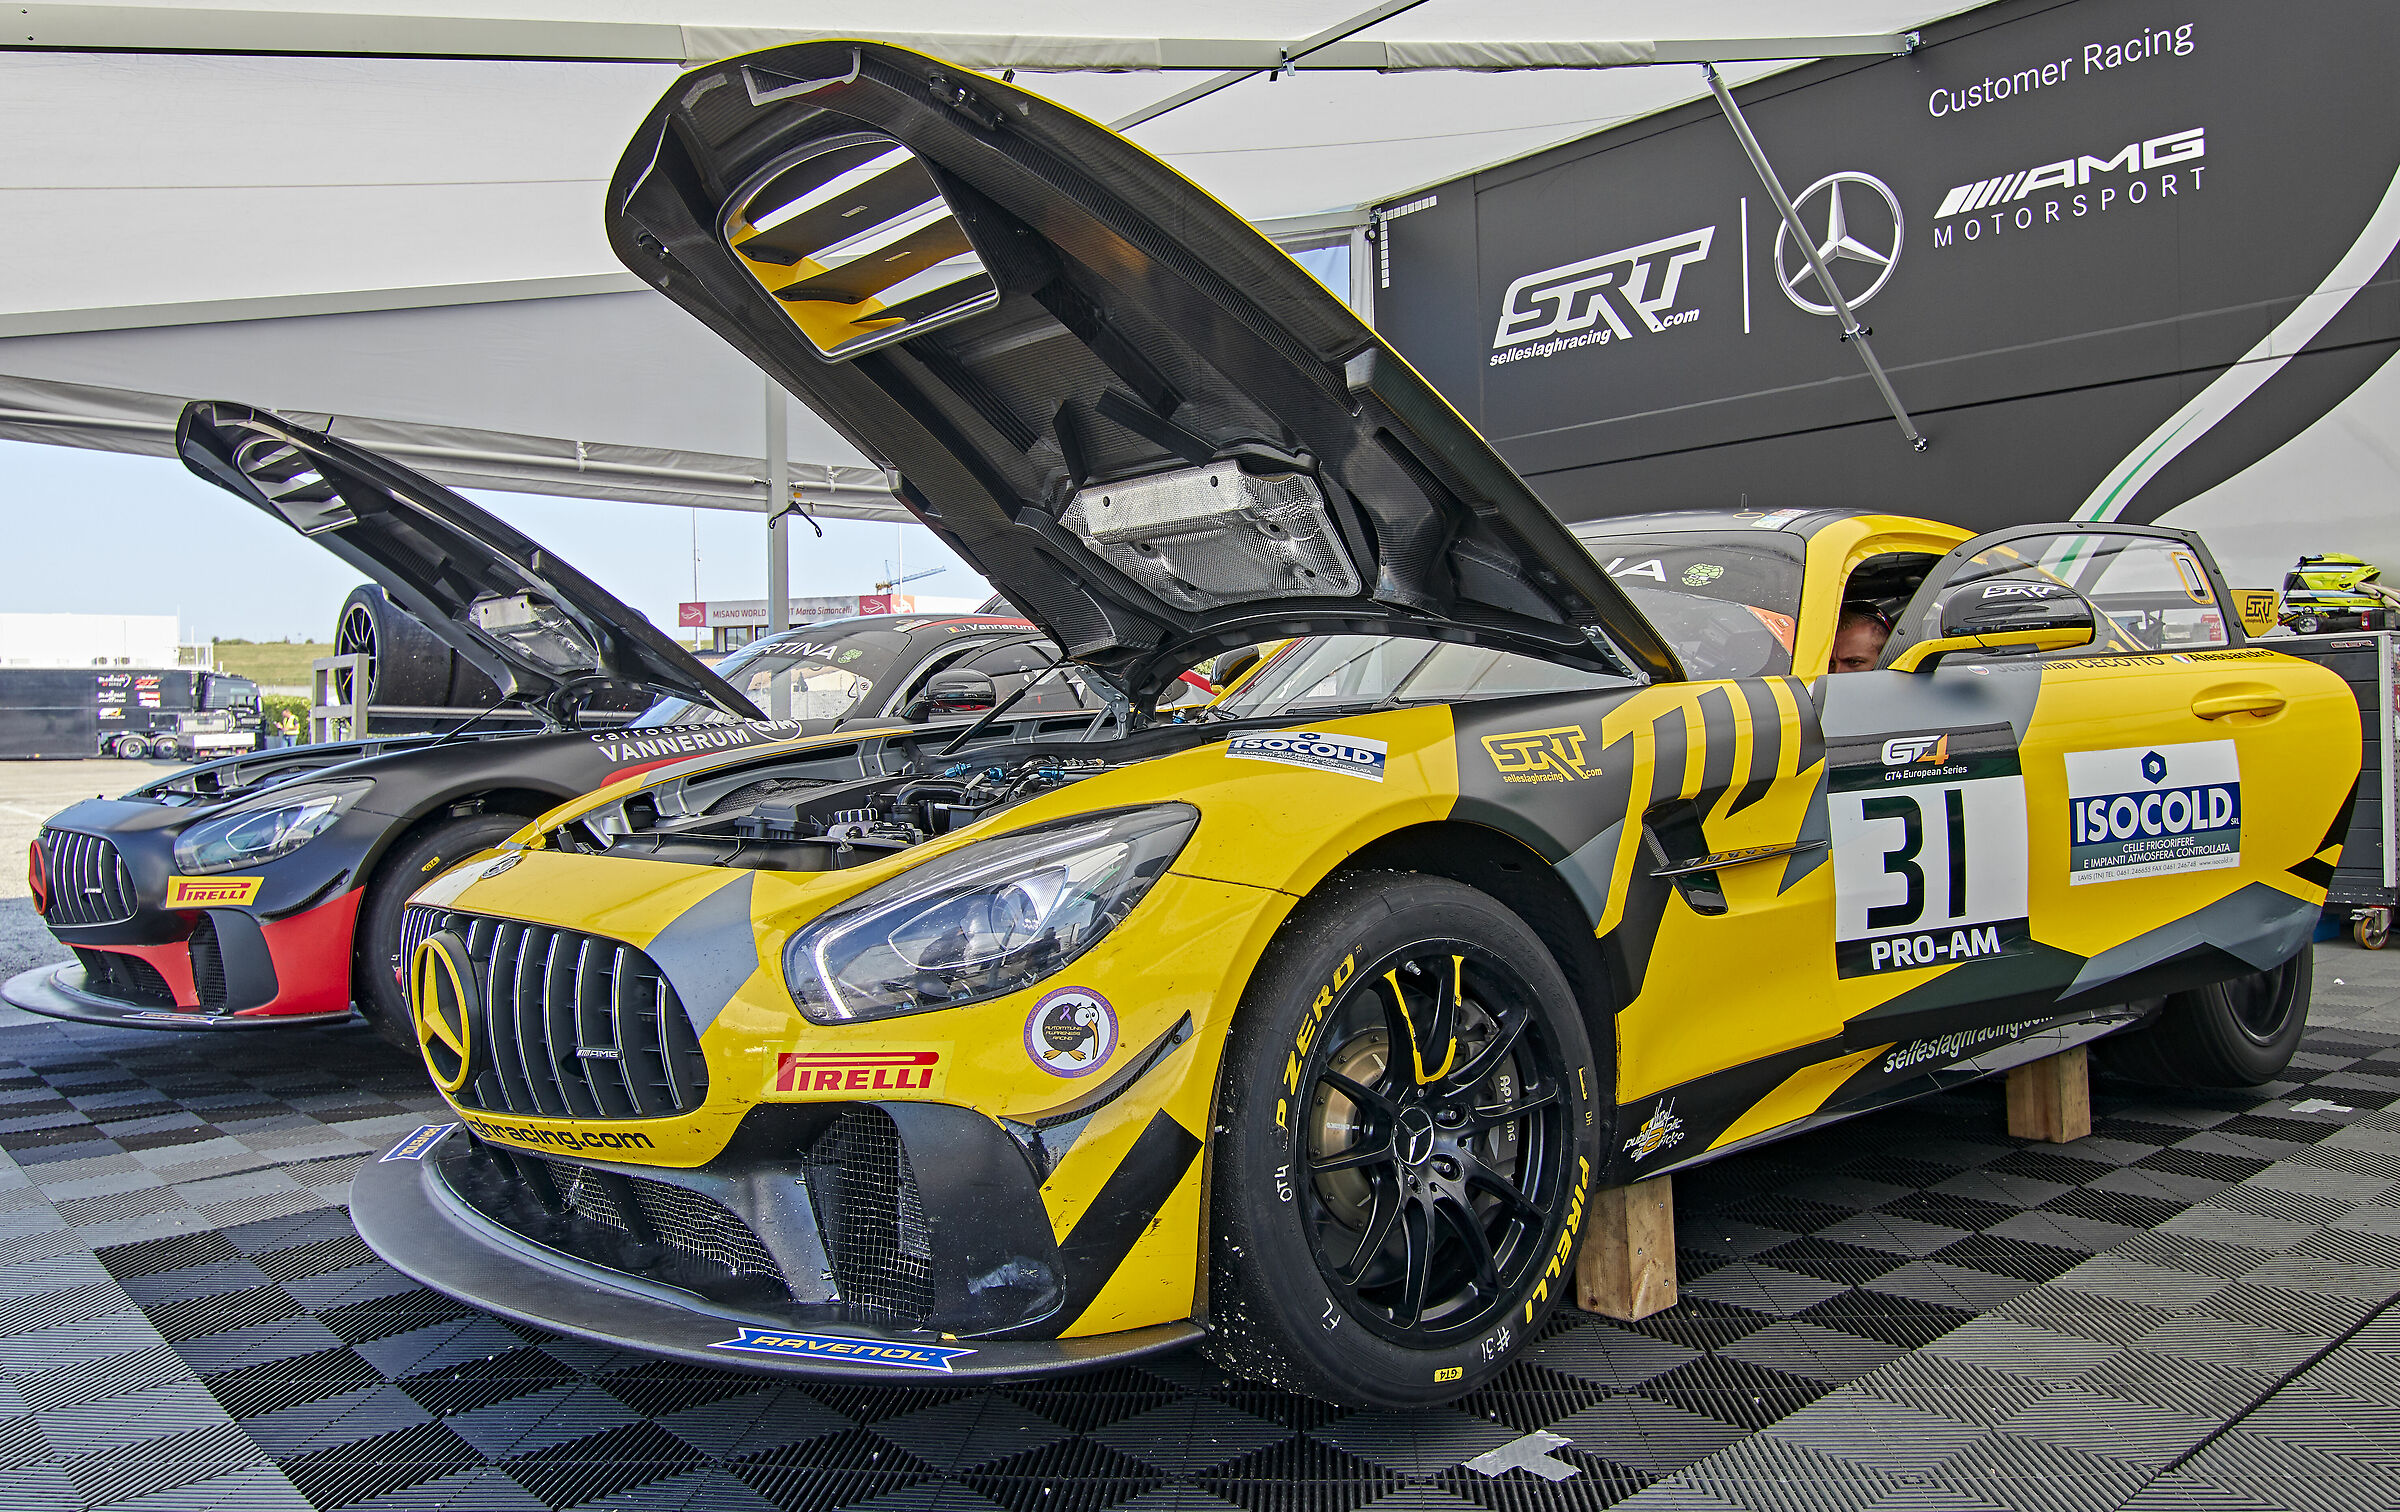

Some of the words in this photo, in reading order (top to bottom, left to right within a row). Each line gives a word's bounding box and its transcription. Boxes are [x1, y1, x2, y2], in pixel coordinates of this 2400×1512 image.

[1929, 58, 2072, 117] Customer
[2083, 22, 2194, 74] Racing
[1934, 167, 2205, 248] MOTORSPORT
[1493, 226, 1716, 340] SRT
[1982, 584, 2058, 598] SRT
[713, 610, 740, 618] MISANO
[741, 608, 766, 617] WORLD
[796, 607, 816, 616] Marco
[818, 605, 852, 614] Simoncelli
[2245, 595, 2273, 623] SRT
[2076, 656, 2165, 670] CECOTTO
[2190, 649, 2274, 662] Alessandro
[599, 728, 750, 762] VANNERUM
[1233, 739, 1375, 764] ISOCOLD
[1481, 725, 1587, 781] SRT
[1882, 733, 1949, 766] GT4
[1885, 771, 1902, 780] GT4
[1903, 768, 1941, 778] European
[1943, 765, 1968, 775] Series
[2076, 788, 2232, 843] ISOCOLD
[2084, 859, 2089, 868] E
[2091, 854, 2126, 868] IMPIANTI
[2128, 850, 2174, 864] ATMOSFERA
[2176, 843, 2230, 857] CONTROLLATA
[2122, 840, 2144, 853] CELLE
[2146, 837, 2194, 850] FRIGORIFERE
[425, 860, 437, 870] GT4
[1861, 788, 1966, 930] 31
[2152, 864, 2162, 872] FAX
[177, 883, 251, 901] PIRELLI
[1870, 926, 2001, 970] PRO-AM
[588, 1050, 619, 1058] AMG
[1275, 1098, 1288, 1134] P
[1284, 953, 1355, 1096] ZERO
[776, 1052, 939, 1092] PIRELLI
[1524, 1156, 1590, 1324] PIRELLI
[750, 1336, 929, 1362] RAVENOL
[1481, 1326, 1511, 1363] #31
[1440, 1369, 1458, 1380] GT4
